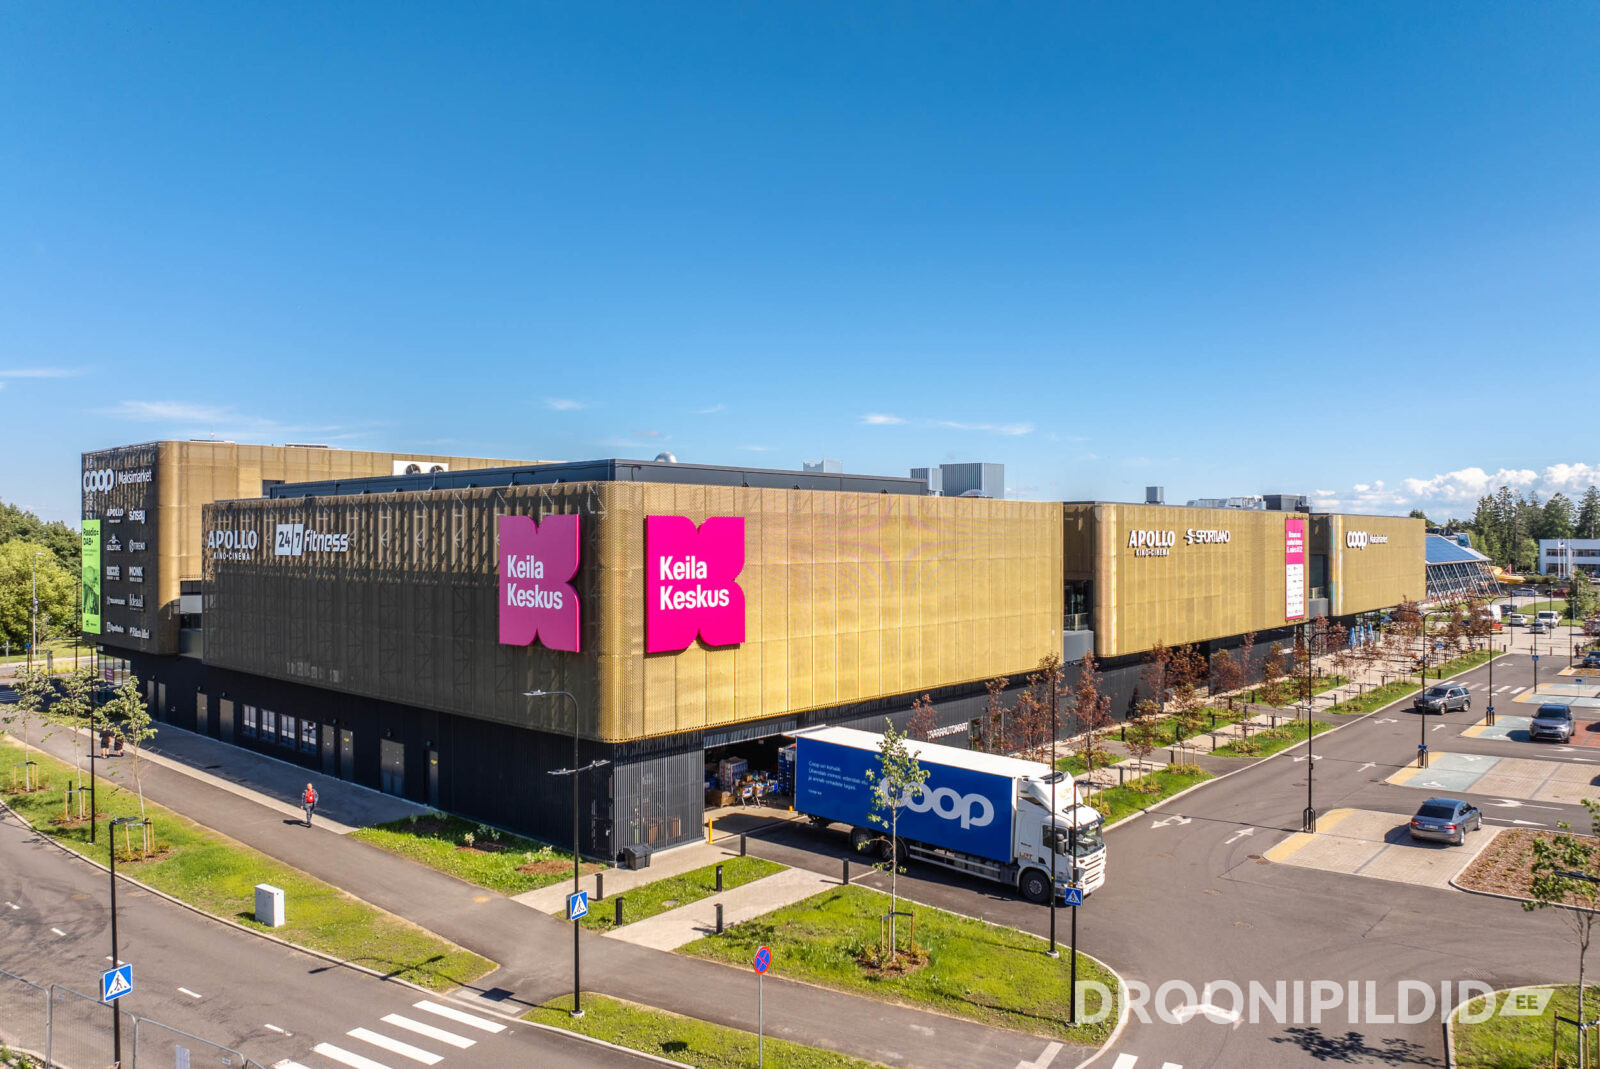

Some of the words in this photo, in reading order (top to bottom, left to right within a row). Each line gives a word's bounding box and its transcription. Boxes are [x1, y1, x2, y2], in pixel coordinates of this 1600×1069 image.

[83, 469, 114, 494] coop
[118, 469, 152, 485] Maksimarket
[107, 508, 124, 517] APOLLO
[207, 530, 258, 549] APOLLO
[304, 530, 349, 552] fitness
[1129, 530, 1175, 548] APOLLO
[1196, 530, 1231, 543] SPORTLAND
[1347, 531, 1367, 550] coop
[507, 555, 544, 579] Keila
[660, 556, 708, 580] Keila
[507, 583, 563, 610] Keskus
[660, 585, 730, 610] Keskus
